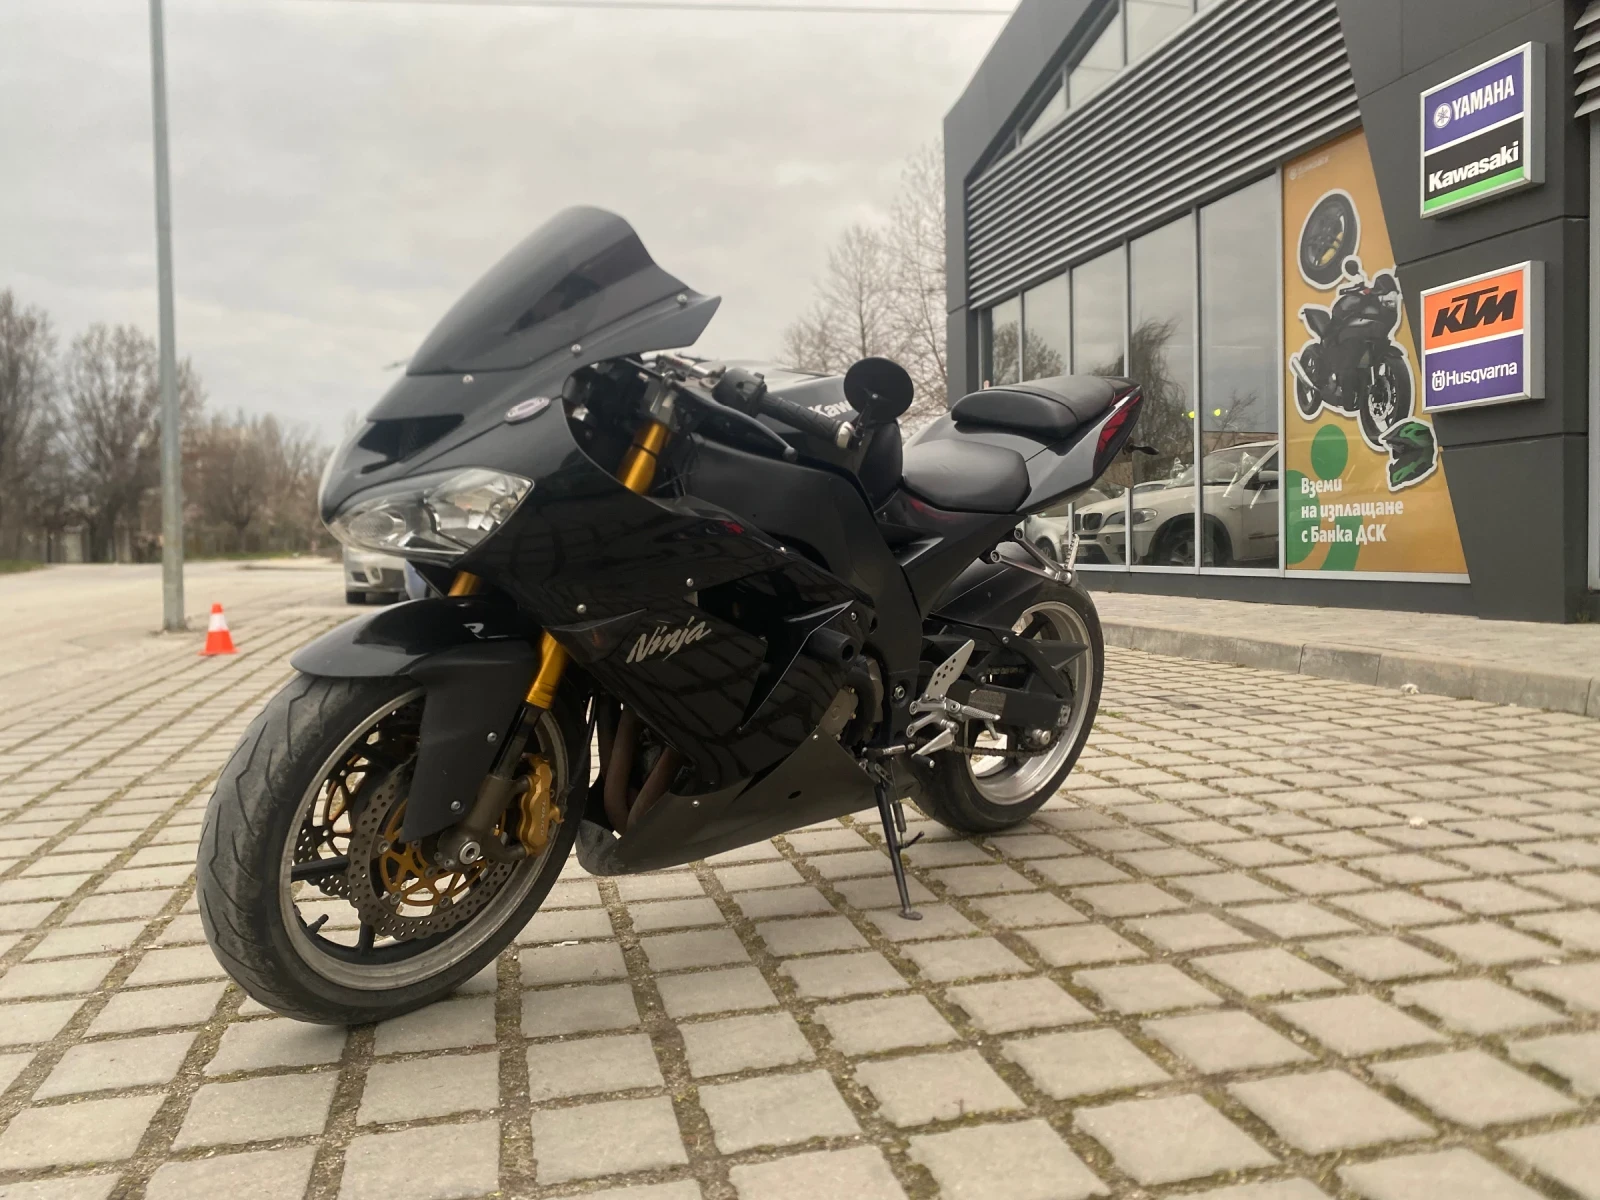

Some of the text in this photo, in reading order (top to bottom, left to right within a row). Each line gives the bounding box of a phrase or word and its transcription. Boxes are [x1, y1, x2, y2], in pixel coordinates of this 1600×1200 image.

[1451, 75, 1514, 120] YAMAHA
[1429, 141, 1518, 192] Kawasaki
[1432, 286, 1517, 337] KTM
[1446, 362, 1517, 387] Husqvarna
[1302, 478, 1342, 498] Вземи
[1301, 500, 1403, 522] на изплащане
[1301, 523, 1387, 545] с Банка ДСК
[626, 615, 712, 663] Ninja
